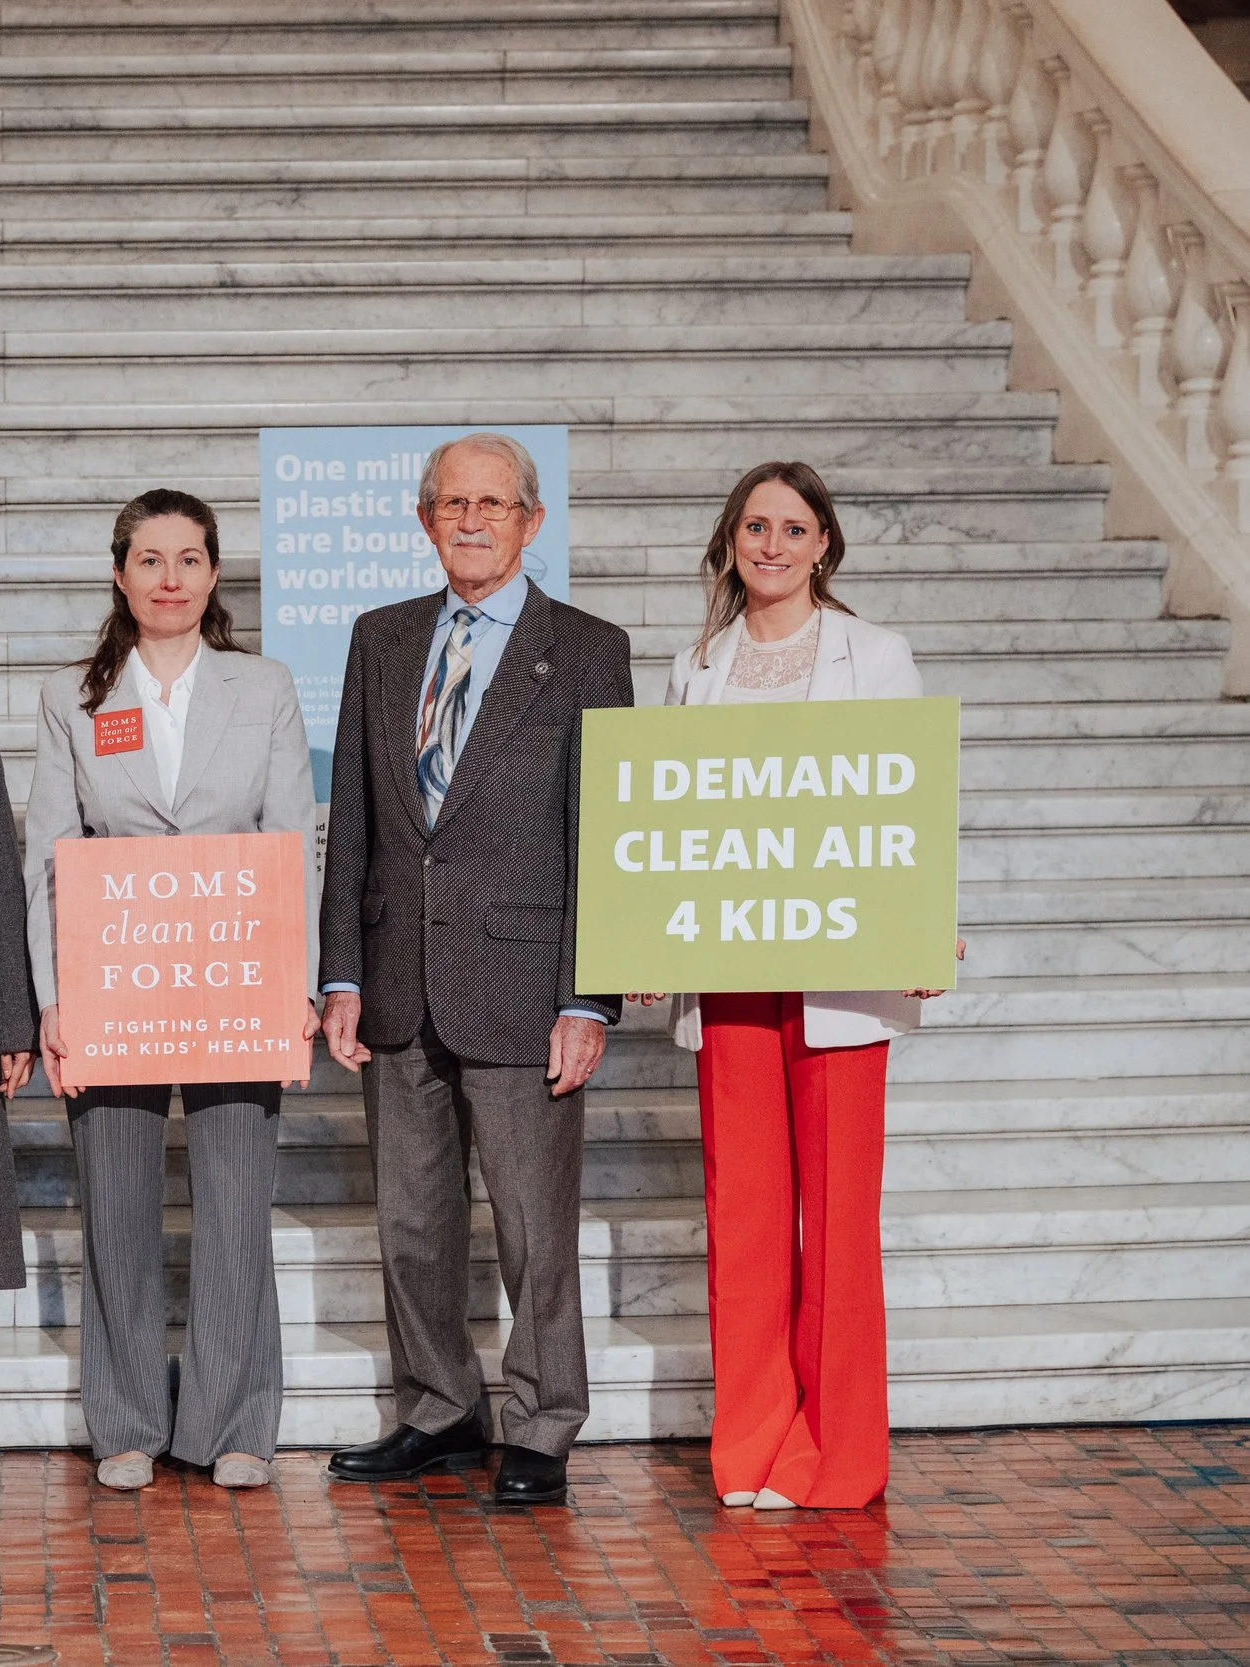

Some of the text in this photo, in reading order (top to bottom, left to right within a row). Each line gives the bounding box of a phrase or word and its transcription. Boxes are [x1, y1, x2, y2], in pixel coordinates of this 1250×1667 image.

[275, 452, 429, 482] One mill
[276, 489, 392, 524] plastic
[275, 525, 433, 559] are boug
[276, 561, 448, 590] worldwid
[303, 690, 317, 700] up
[319, 688, 329, 698] in
[100, 716, 137, 728] MOMS
[100, 726, 137, 737] clean air
[100, 734, 138, 746] FORCE
[618, 753, 917, 802] I DEMAND
[614, 824, 917, 873] CLEAN AIR
[101, 869, 257, 900] MOMS
[101, 909, 261, 945] clean air
[665, 897, 858, 943] 4 KIDS
[100, 961, 263, 990] FORCE
[104, 1018, 262, 1034] FIGHTING FOR
[85, 1038, 291, 1057] OUR KIDS' HEALTH
